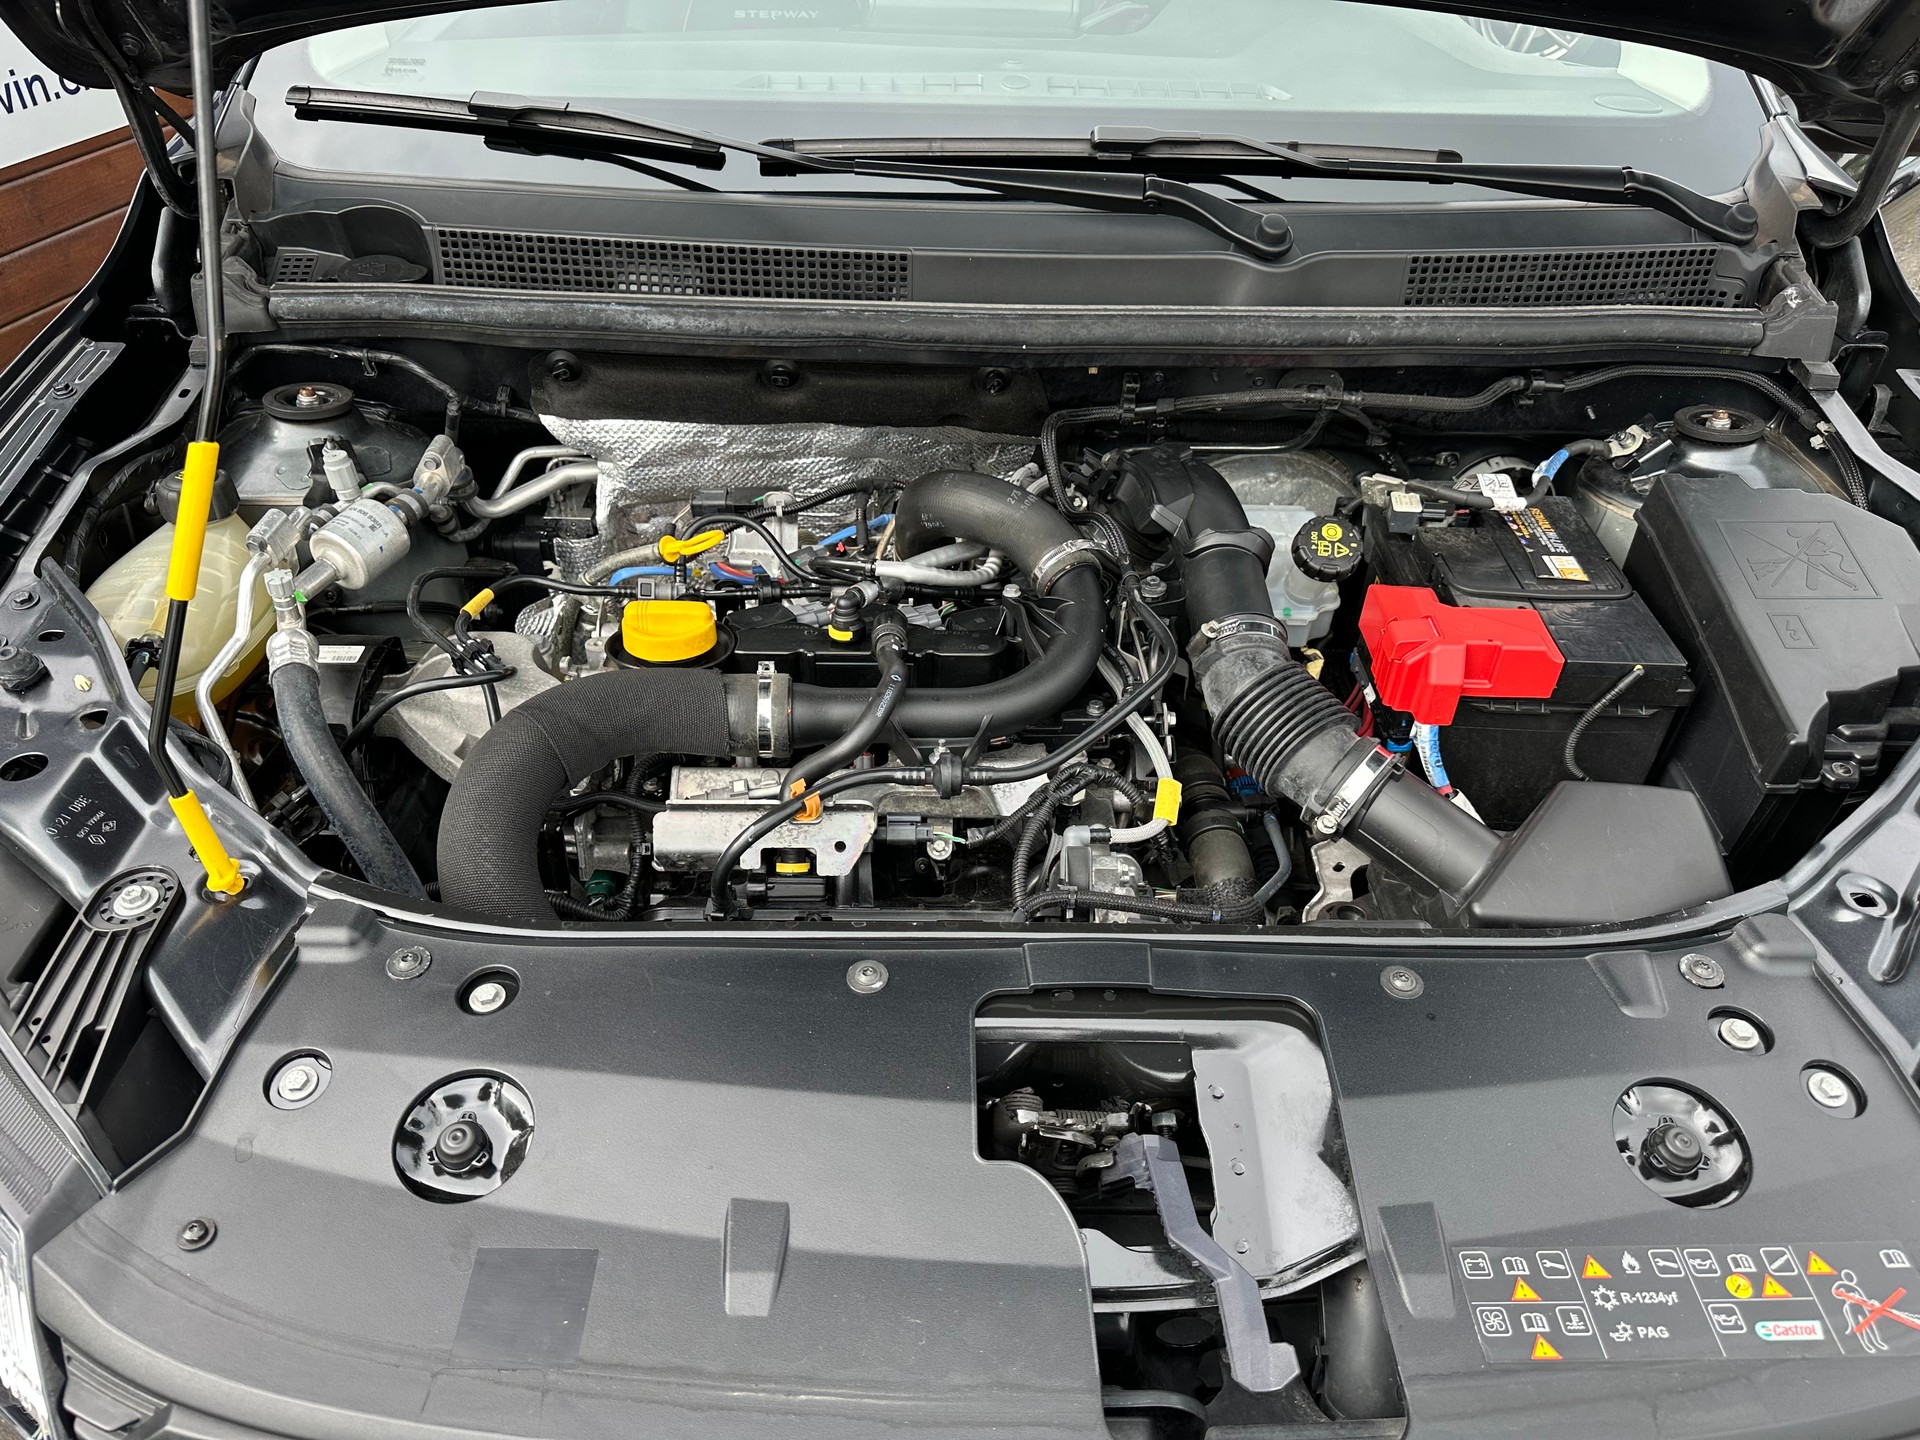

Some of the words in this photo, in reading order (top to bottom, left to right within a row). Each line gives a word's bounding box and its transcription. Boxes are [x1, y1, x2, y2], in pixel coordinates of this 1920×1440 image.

[734, 9, 819, 20] STEPWAY
[1310, 531, 1319, 545] DOT
[1620, 1291, 1679, 1306] R-1234yf
[1636, 1326, 1670, 1339] PAG
[1773, 1324, 1818, 1337] Castrol
